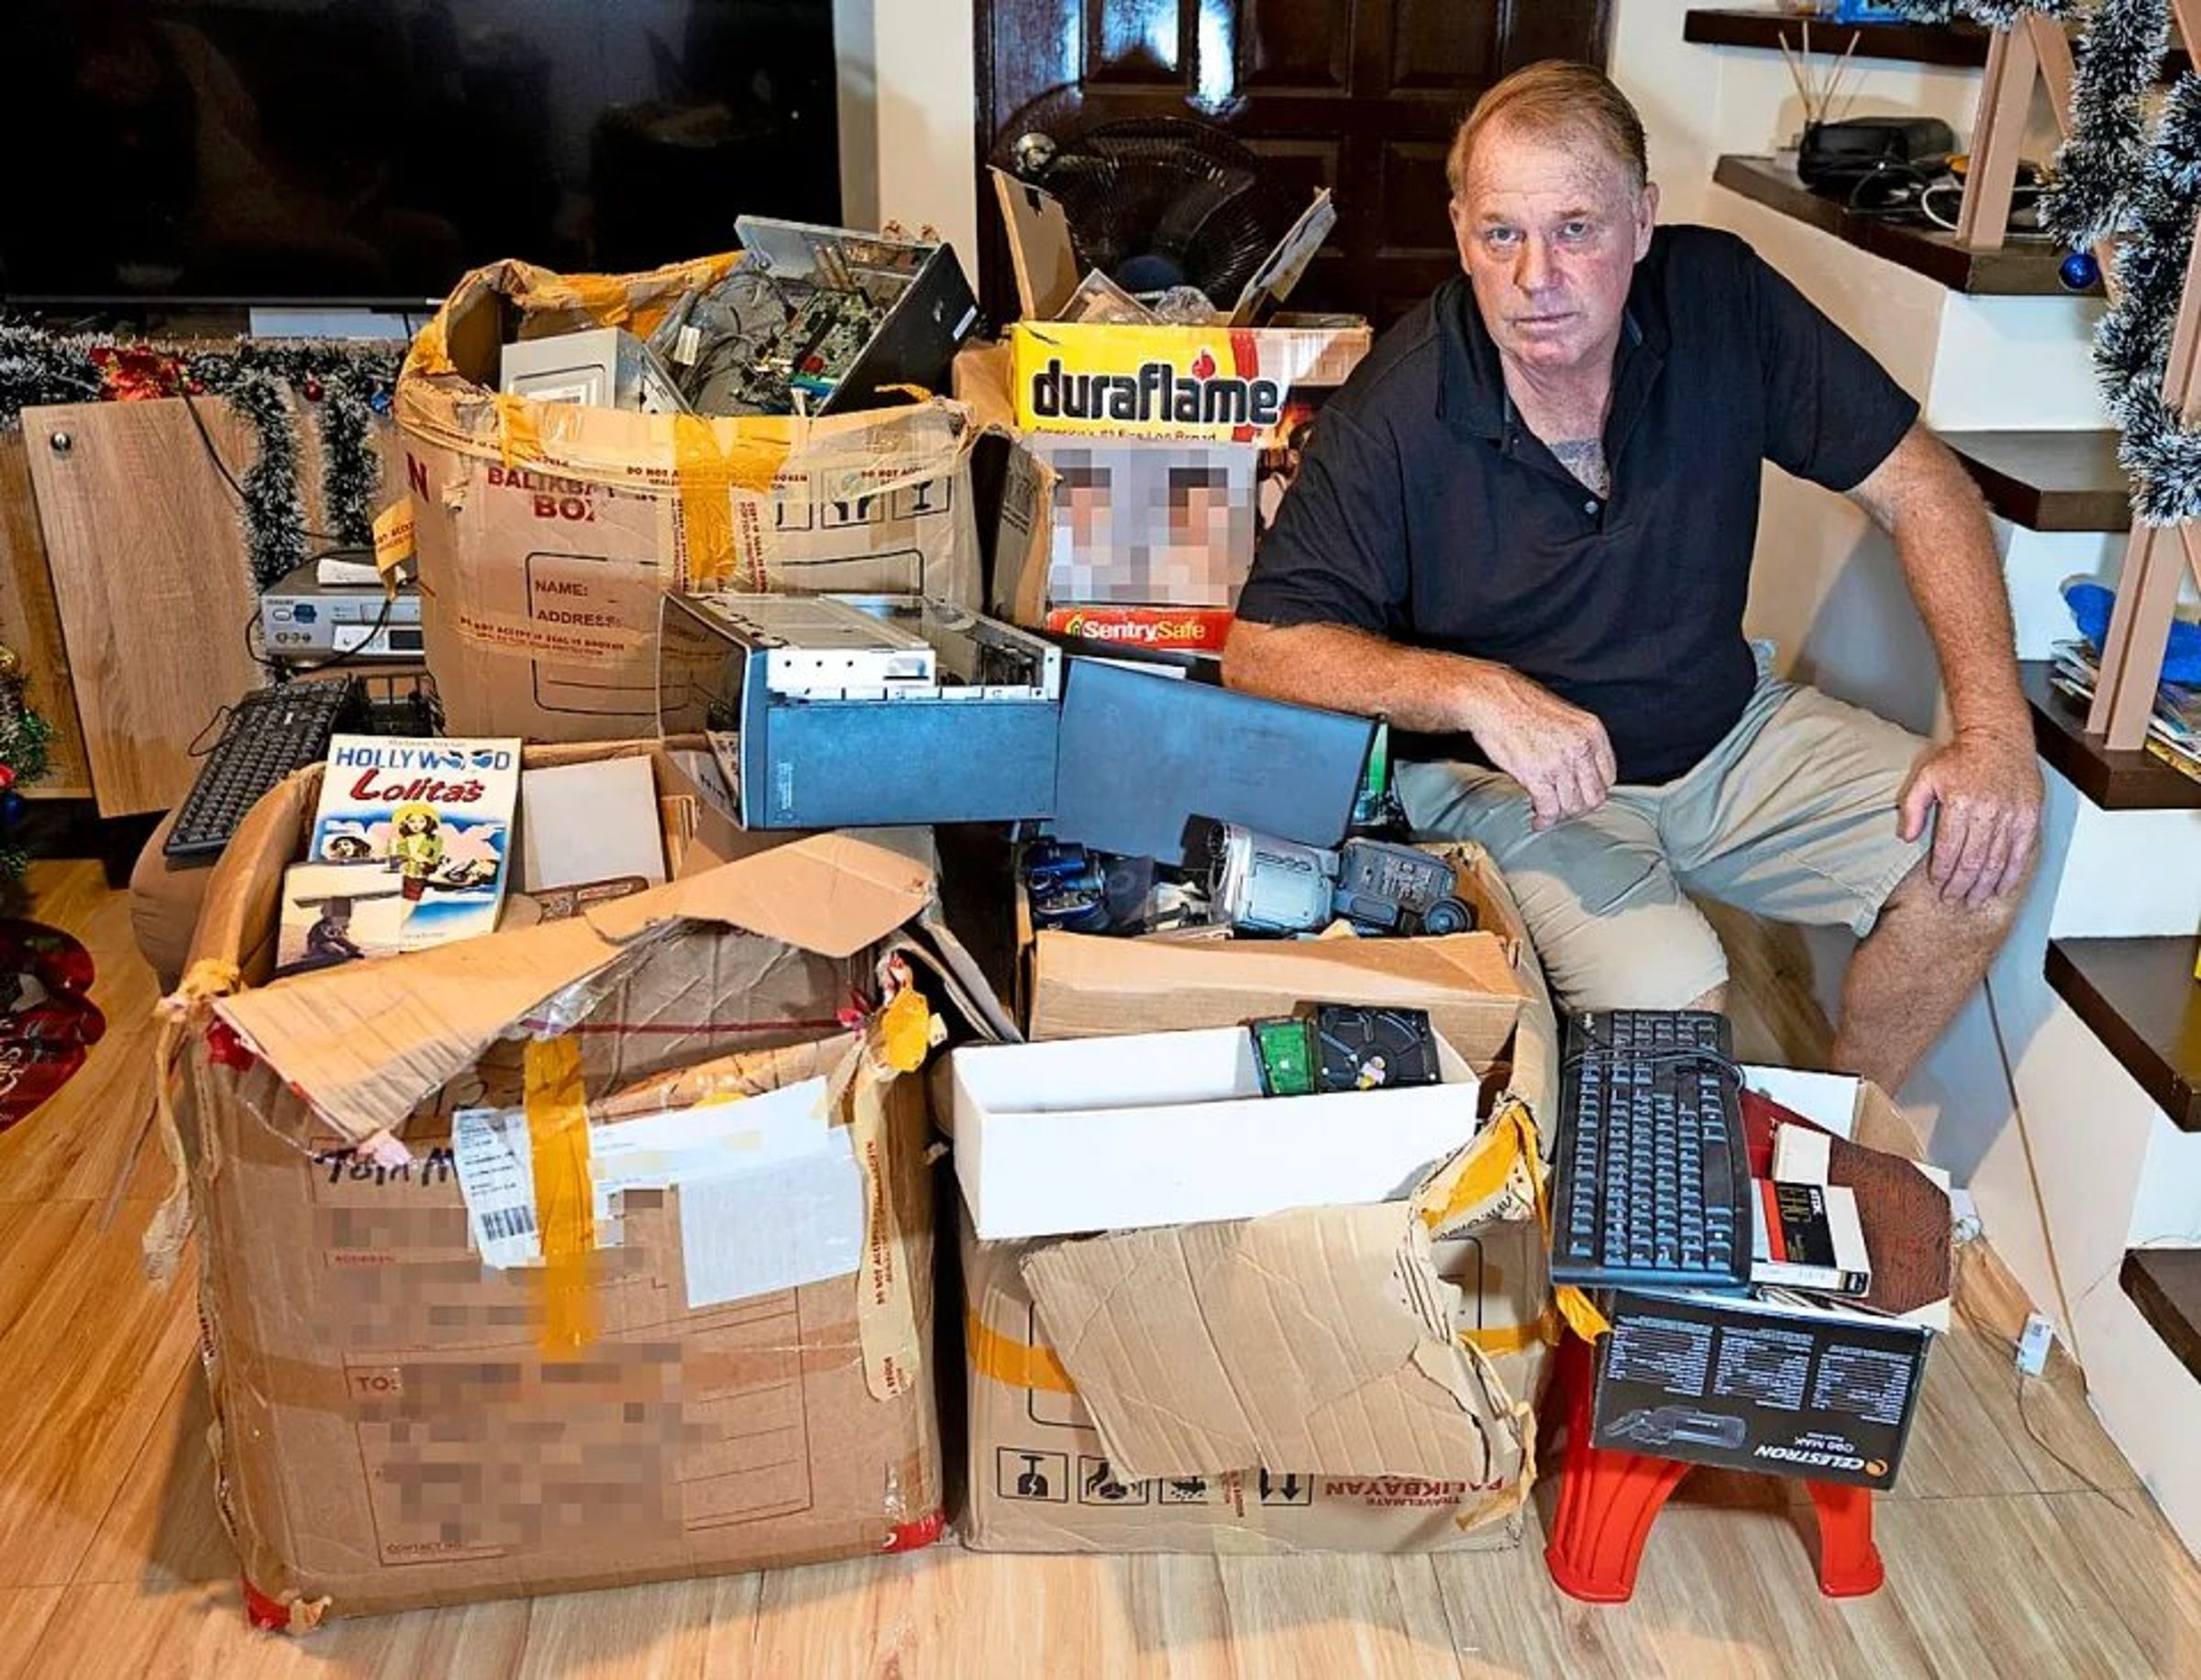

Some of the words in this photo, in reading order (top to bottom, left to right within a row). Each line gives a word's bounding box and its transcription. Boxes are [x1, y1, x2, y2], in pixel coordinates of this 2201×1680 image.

[1033, 359, 1281, 426] duraflame
[406, 451, 430, 503] N
[535, 579, 589, 597] NAME:
[1082, 619, 1205, 642] SentrySafe
[358, 1376, 398, 1392] TO:
[1753, 1444, 1865, 1471] CELESTRON
[1365, 1496, 1462, 1508] TRAVELMATE
